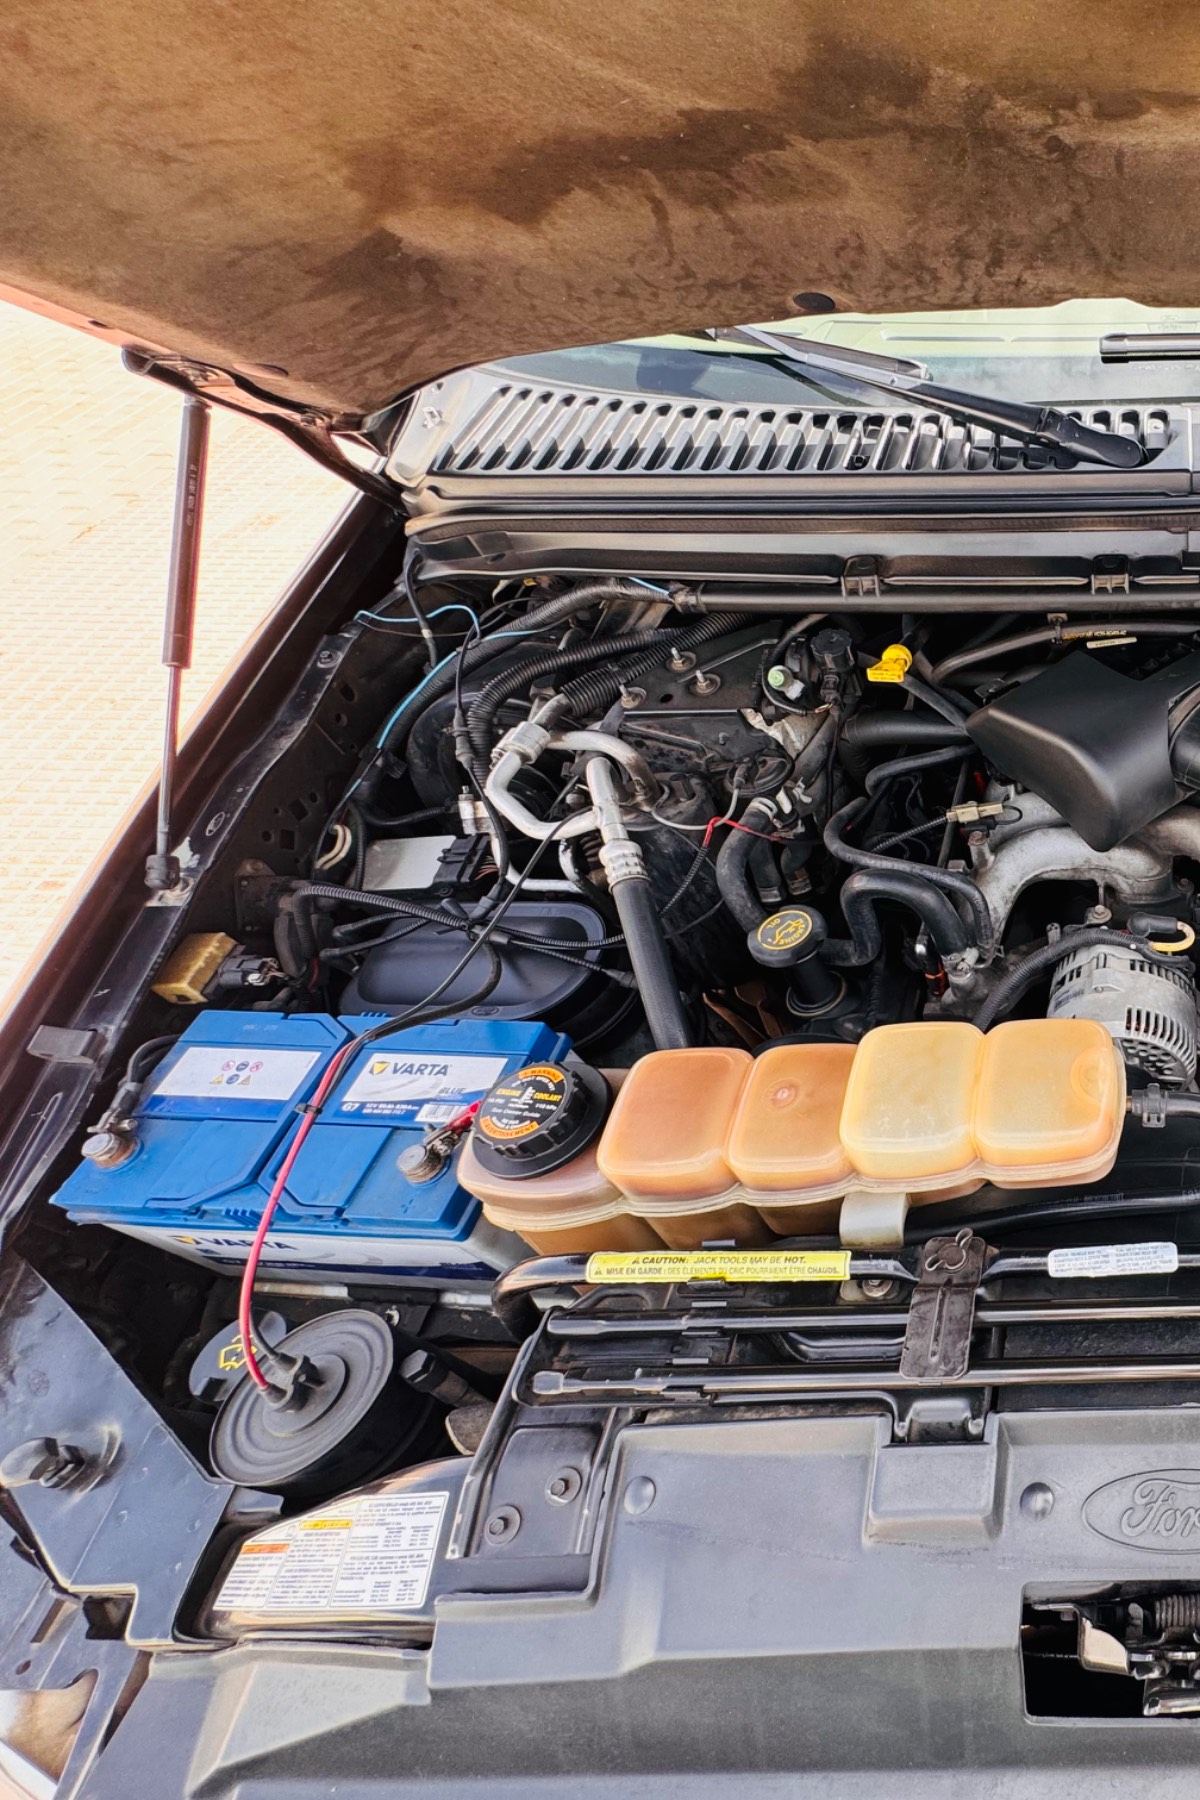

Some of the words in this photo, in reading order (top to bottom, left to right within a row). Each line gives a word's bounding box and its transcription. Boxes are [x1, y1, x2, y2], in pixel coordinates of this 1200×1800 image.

[766, 918, 780, 929] OIL
[392, 1062, 448, 1076] VARTA
[533, 1092, 562, 1102] COOLANT
[341, 1102, 360, 1112] G7
[642, 1256, 689, 1264] CAUTION:
[693, 1256, 718, 1264] JACK
[720, 1256, 749, 1264] TOOLS
[750, 1256, 768, 1265] MAY
[769, 1256, 782, 1264] BE
[784, 1256, 806, 1264] HOT.
[606, 1266, 624, 1275] MISE
[626, 1266, 636, 1275] EN
[668, 1266, 681, 1275] DES
[745, 1266, 788, 1275] POURRAIENT
[807, 1266, 840, 1275] CHAUDS.
